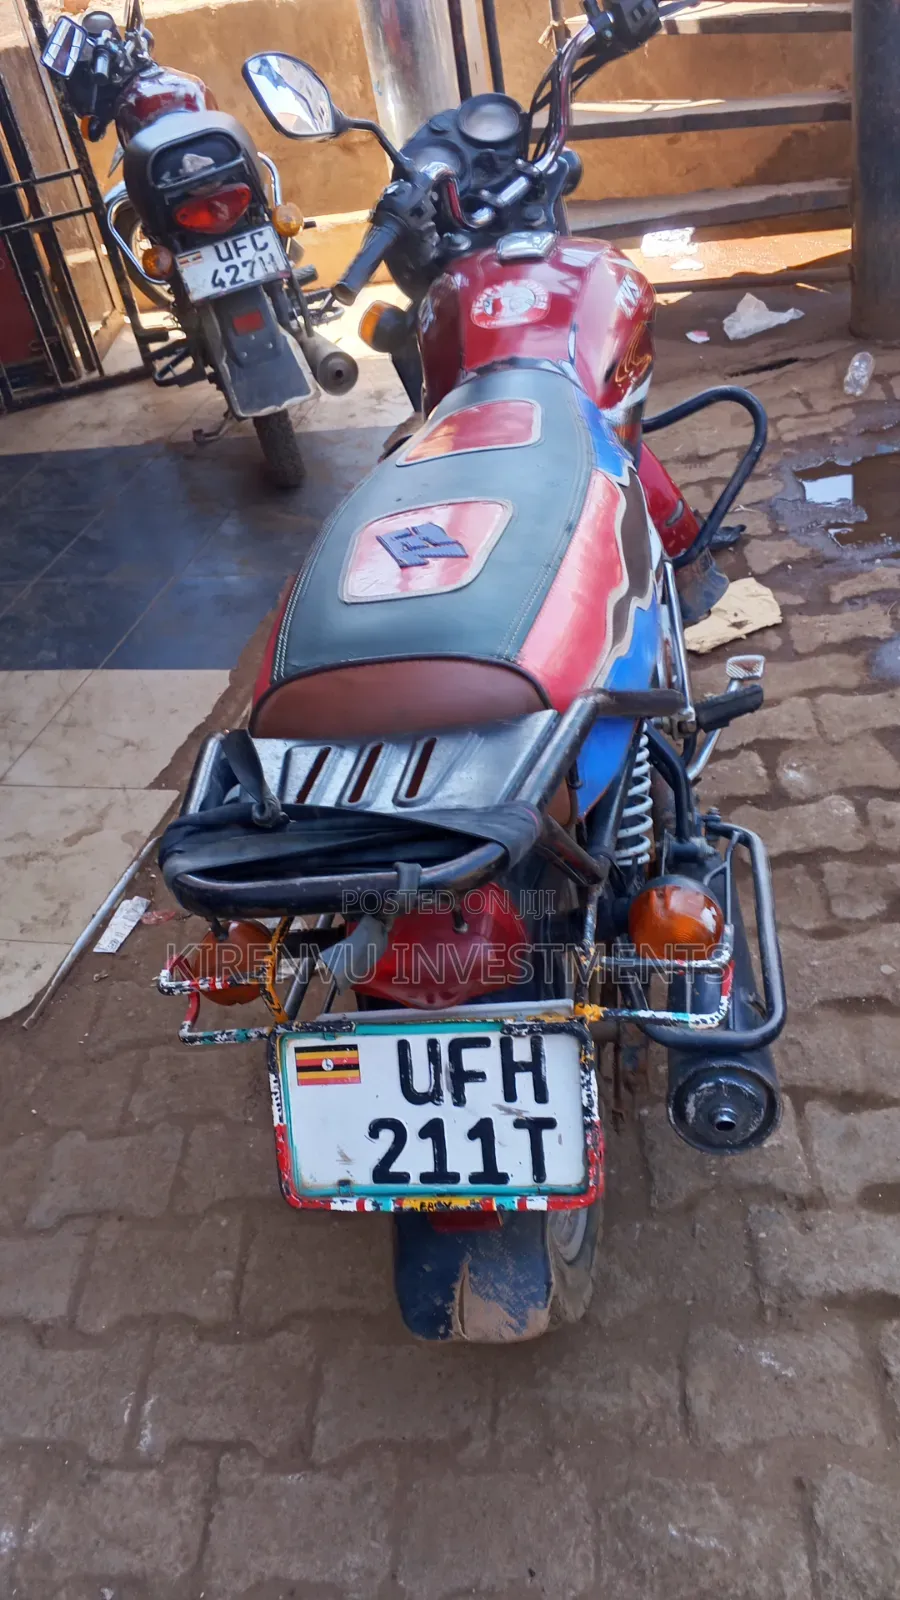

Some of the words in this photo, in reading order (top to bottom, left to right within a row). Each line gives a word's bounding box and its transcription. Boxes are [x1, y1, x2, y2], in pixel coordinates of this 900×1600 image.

[214, 231, 268, 262] UFC
[397, 1035, 549, 1107] UFH
[368, 1117, 557, 1184] 211T
